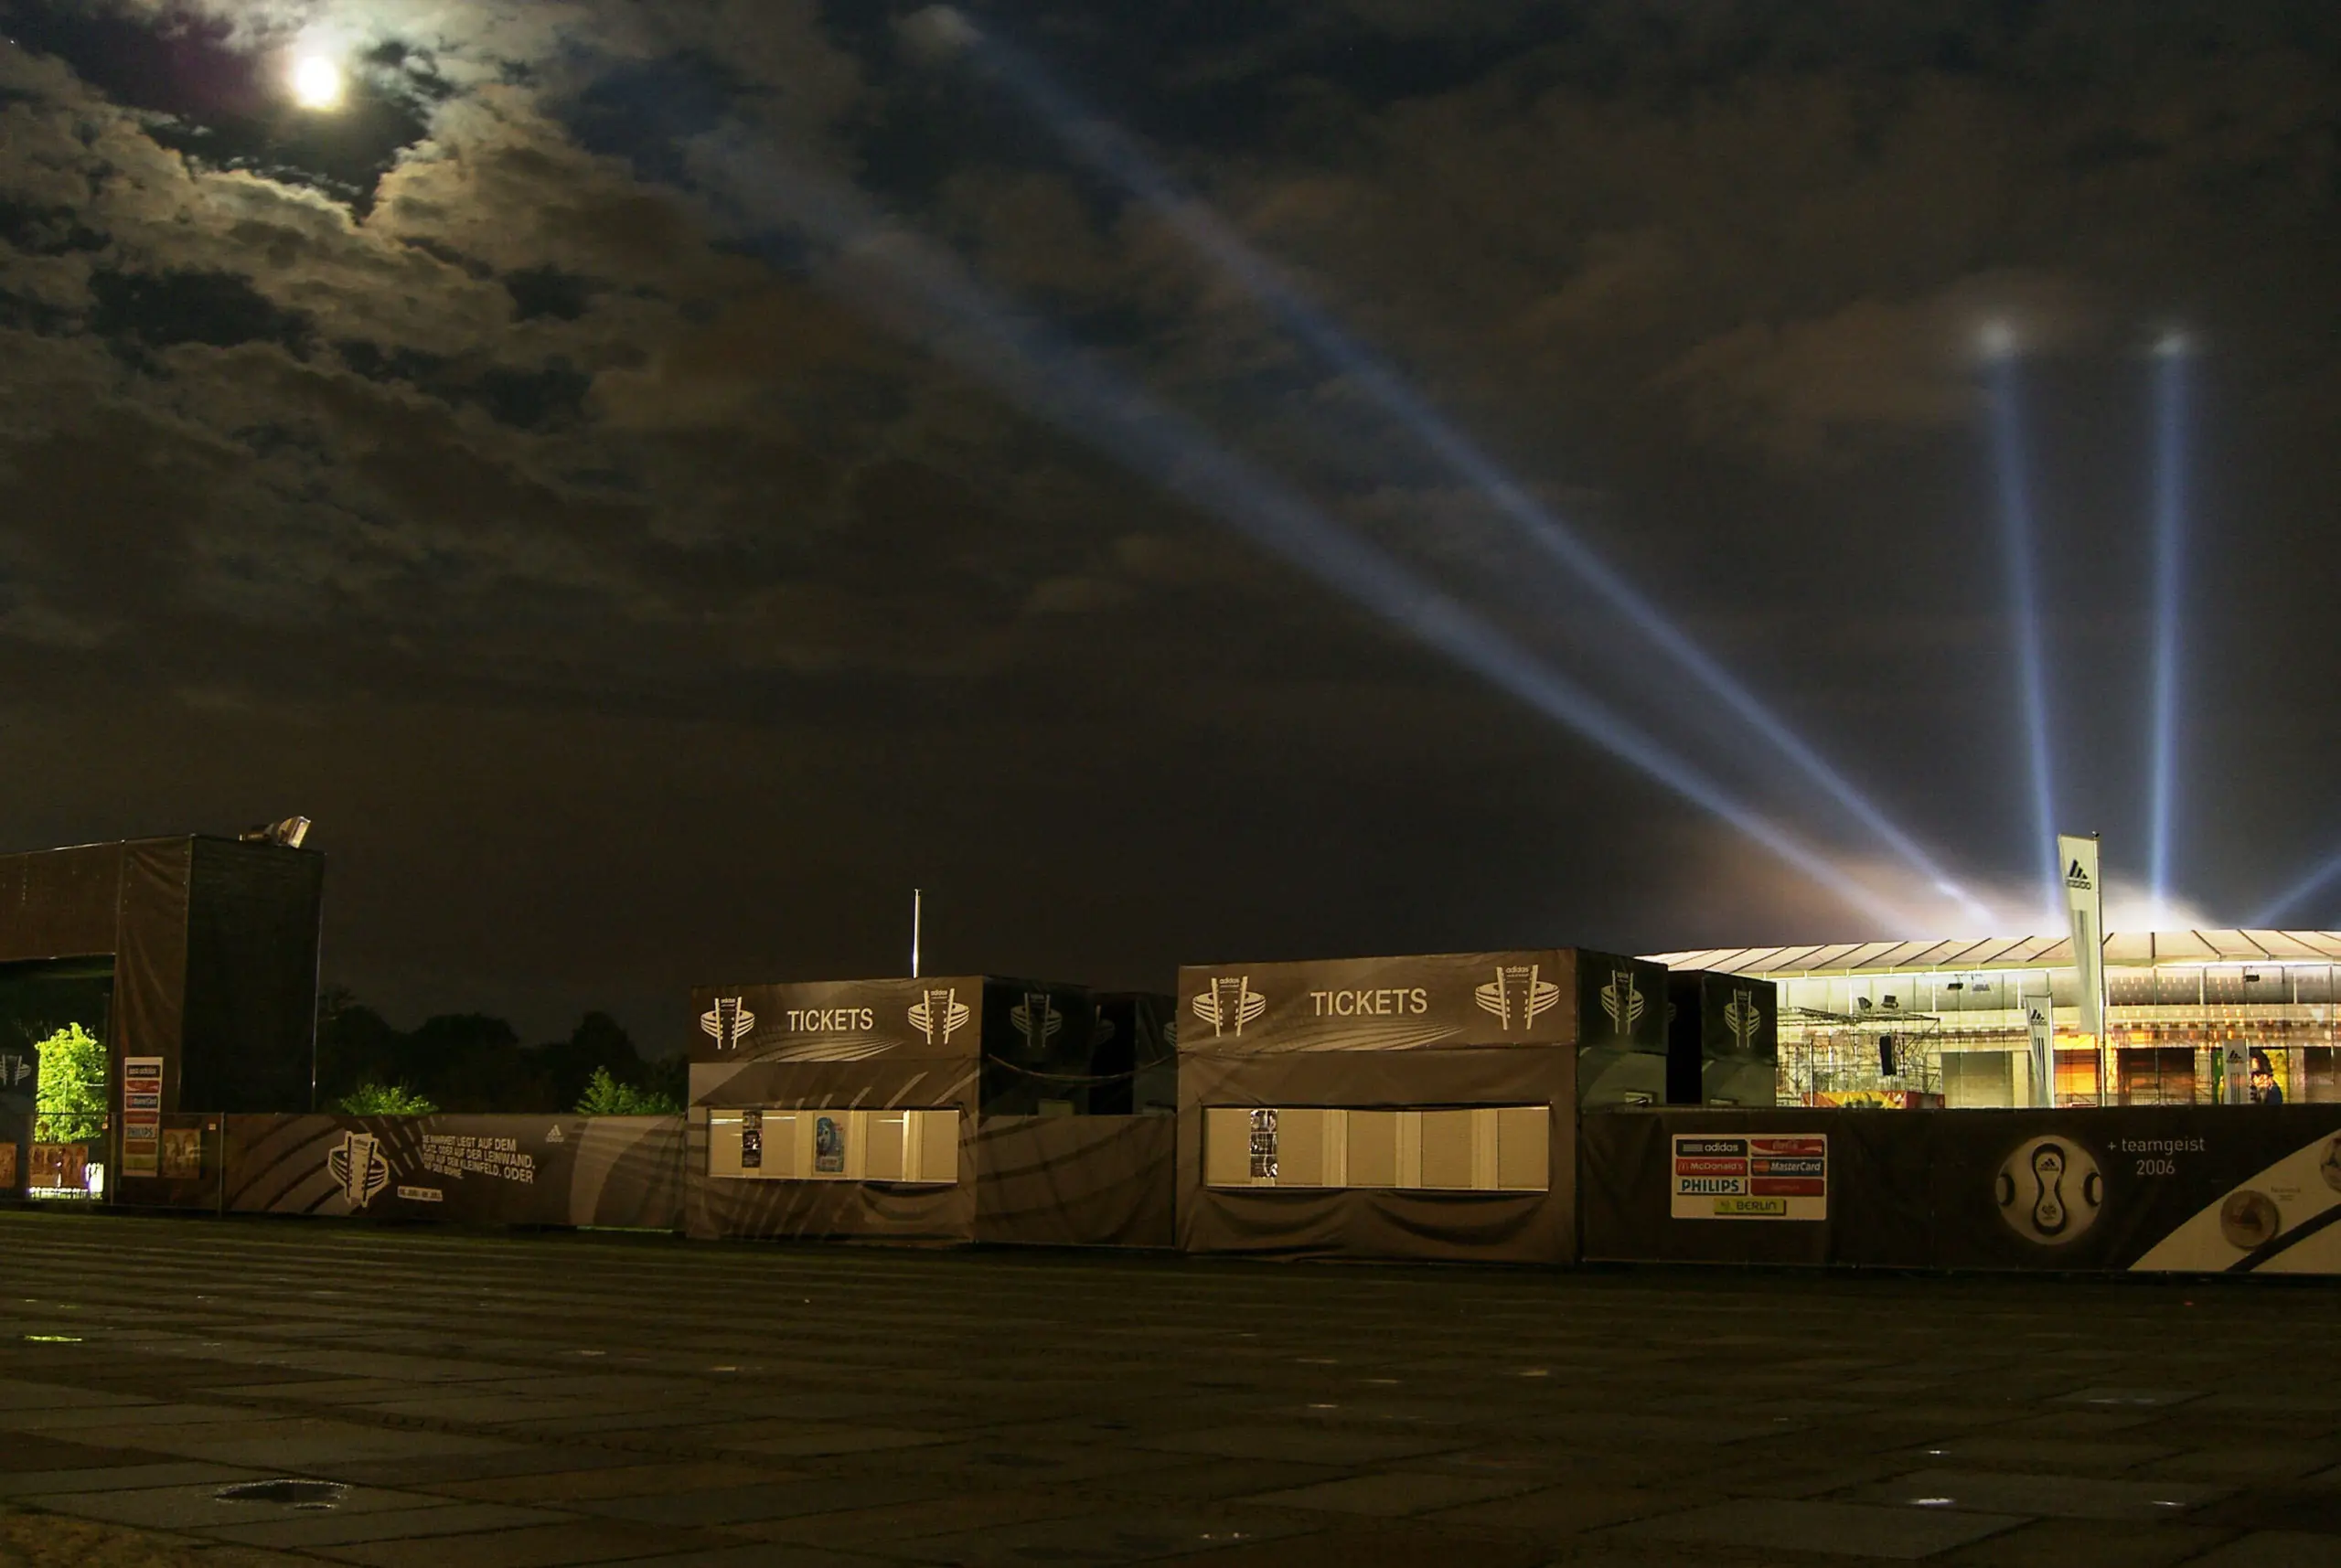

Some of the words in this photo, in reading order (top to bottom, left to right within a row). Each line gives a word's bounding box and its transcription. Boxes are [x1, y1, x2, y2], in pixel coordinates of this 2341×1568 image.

[1309, 987, 1428, 1017] TICKETS
[786, 1008, 874, 1032] TICKETS
[495, 1137, 517, 1151] DEM
[1705, 1142, 1739, 1153] adidas
[2122, 1136, 2206, 1156] teamgeist
[1690, 1160, 1744, 1171] McDonald's
[1770, 1161, 1822, 1171] MasterCard
[2136, 1159, 2175, 1176] 2006
[503, 1166, 533, 1184] ODER
[1682, 1179, 1739, 1192] PHILIPS
